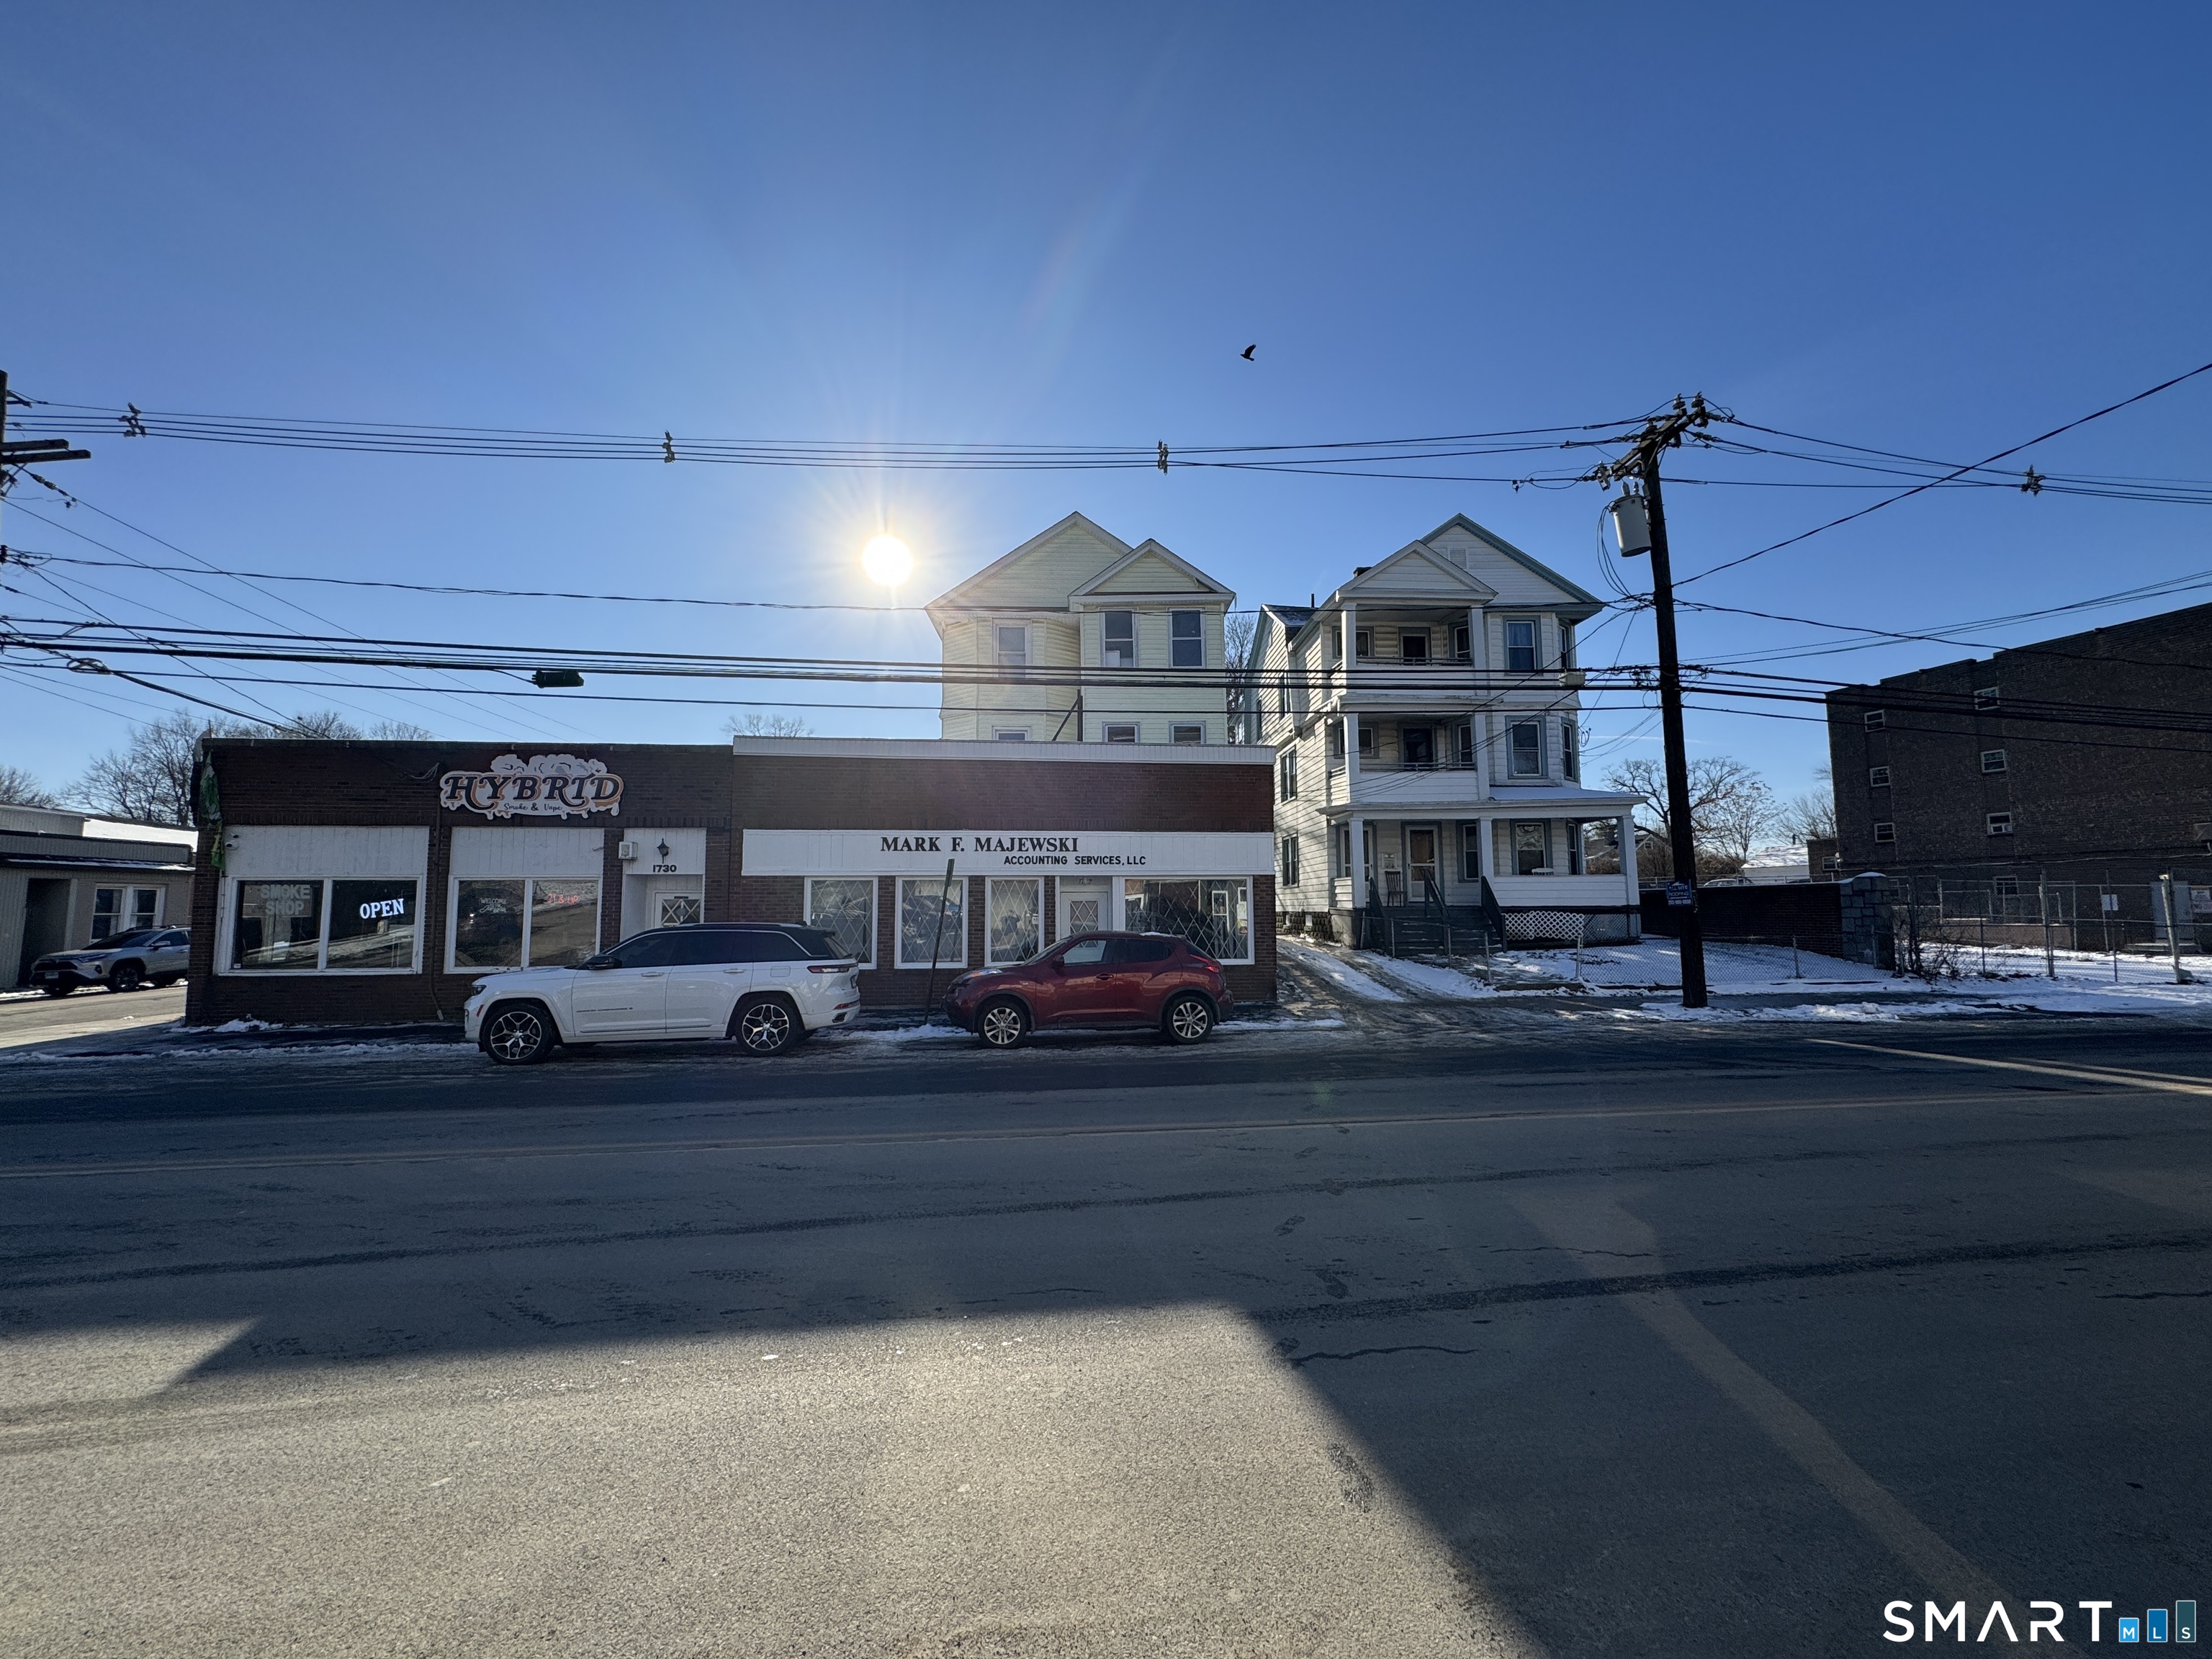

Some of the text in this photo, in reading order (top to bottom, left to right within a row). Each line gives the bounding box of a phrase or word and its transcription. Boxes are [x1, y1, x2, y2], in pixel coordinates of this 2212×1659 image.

[444, 775, 621, 811] HYBRID
[504, 803, 528, 811] Smoke
[880, 836, 1079, 853] MARK F. MAJEWSKI
[1003, 855, 1146, 866] ACCOUNTING SERVICES, LLC
[652, 864, 678, 873] 1730
[260, 884, 311, 899] SMOKE
[266, 899, 305, 915] SHOP
[359, 898, 405, 920] OPEN
